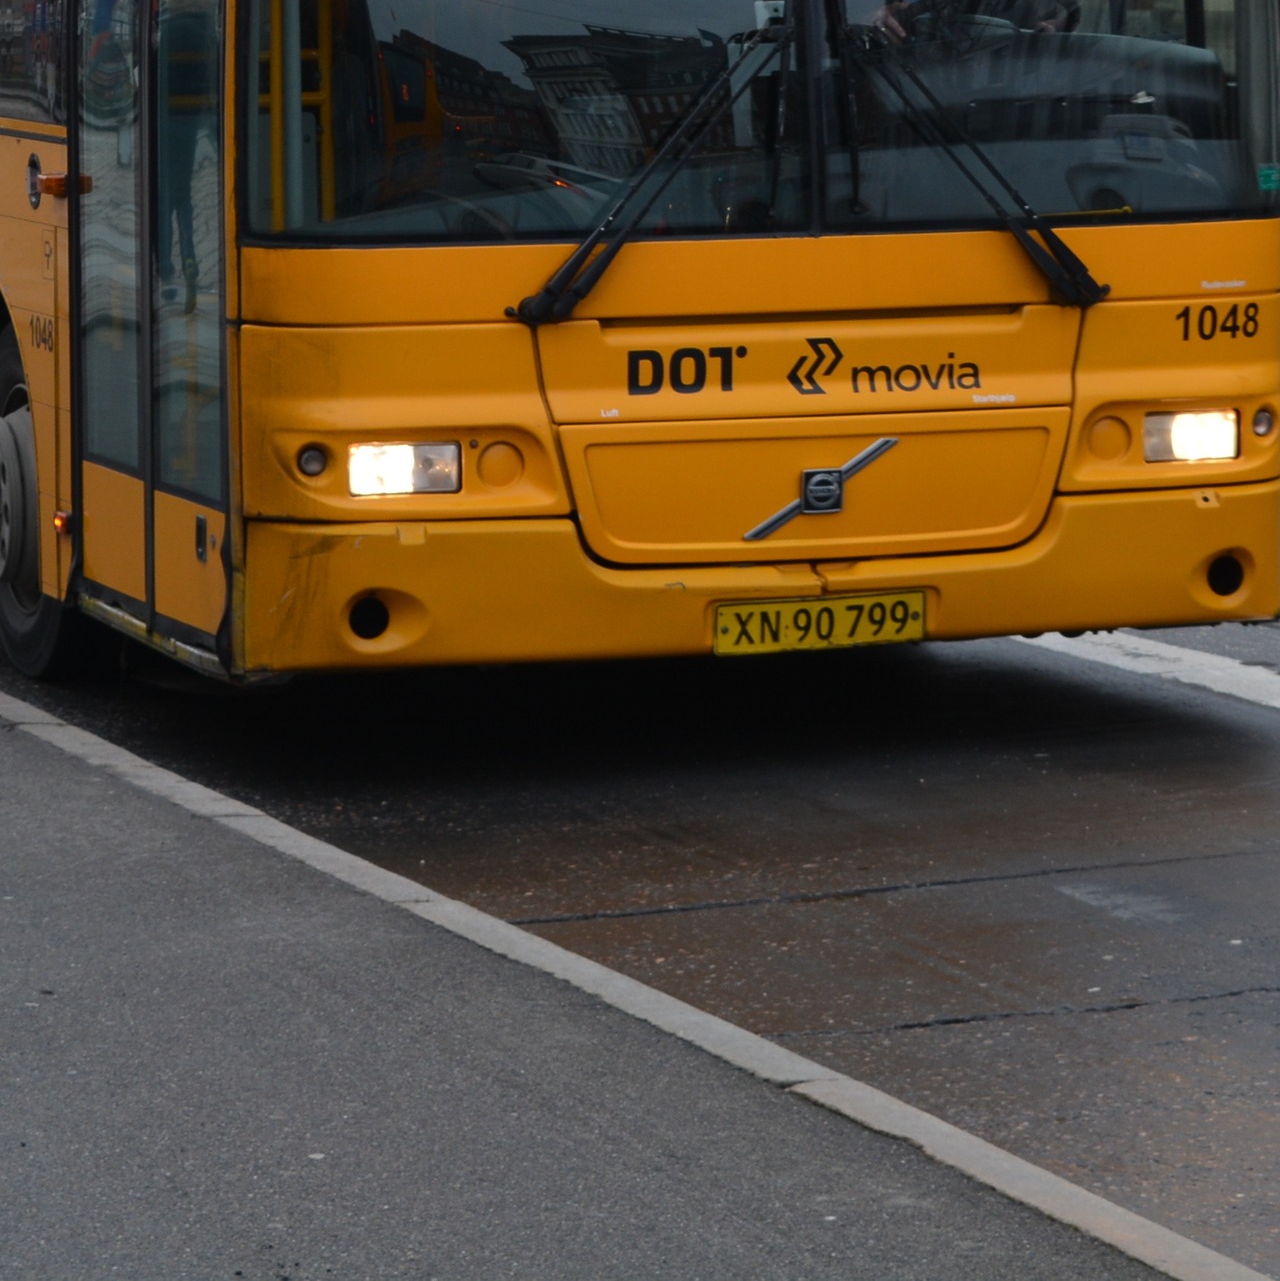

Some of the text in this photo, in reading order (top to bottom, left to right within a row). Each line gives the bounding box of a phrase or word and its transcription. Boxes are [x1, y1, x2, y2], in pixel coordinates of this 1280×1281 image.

[29, 313, 54, 353] 1048
[1175, 302, 1259, 341] 1048
[627, 346, 748, 396] DOT
[852, 352, 982, 393] movia
[733, 600, 910, 646] XN 90 799
